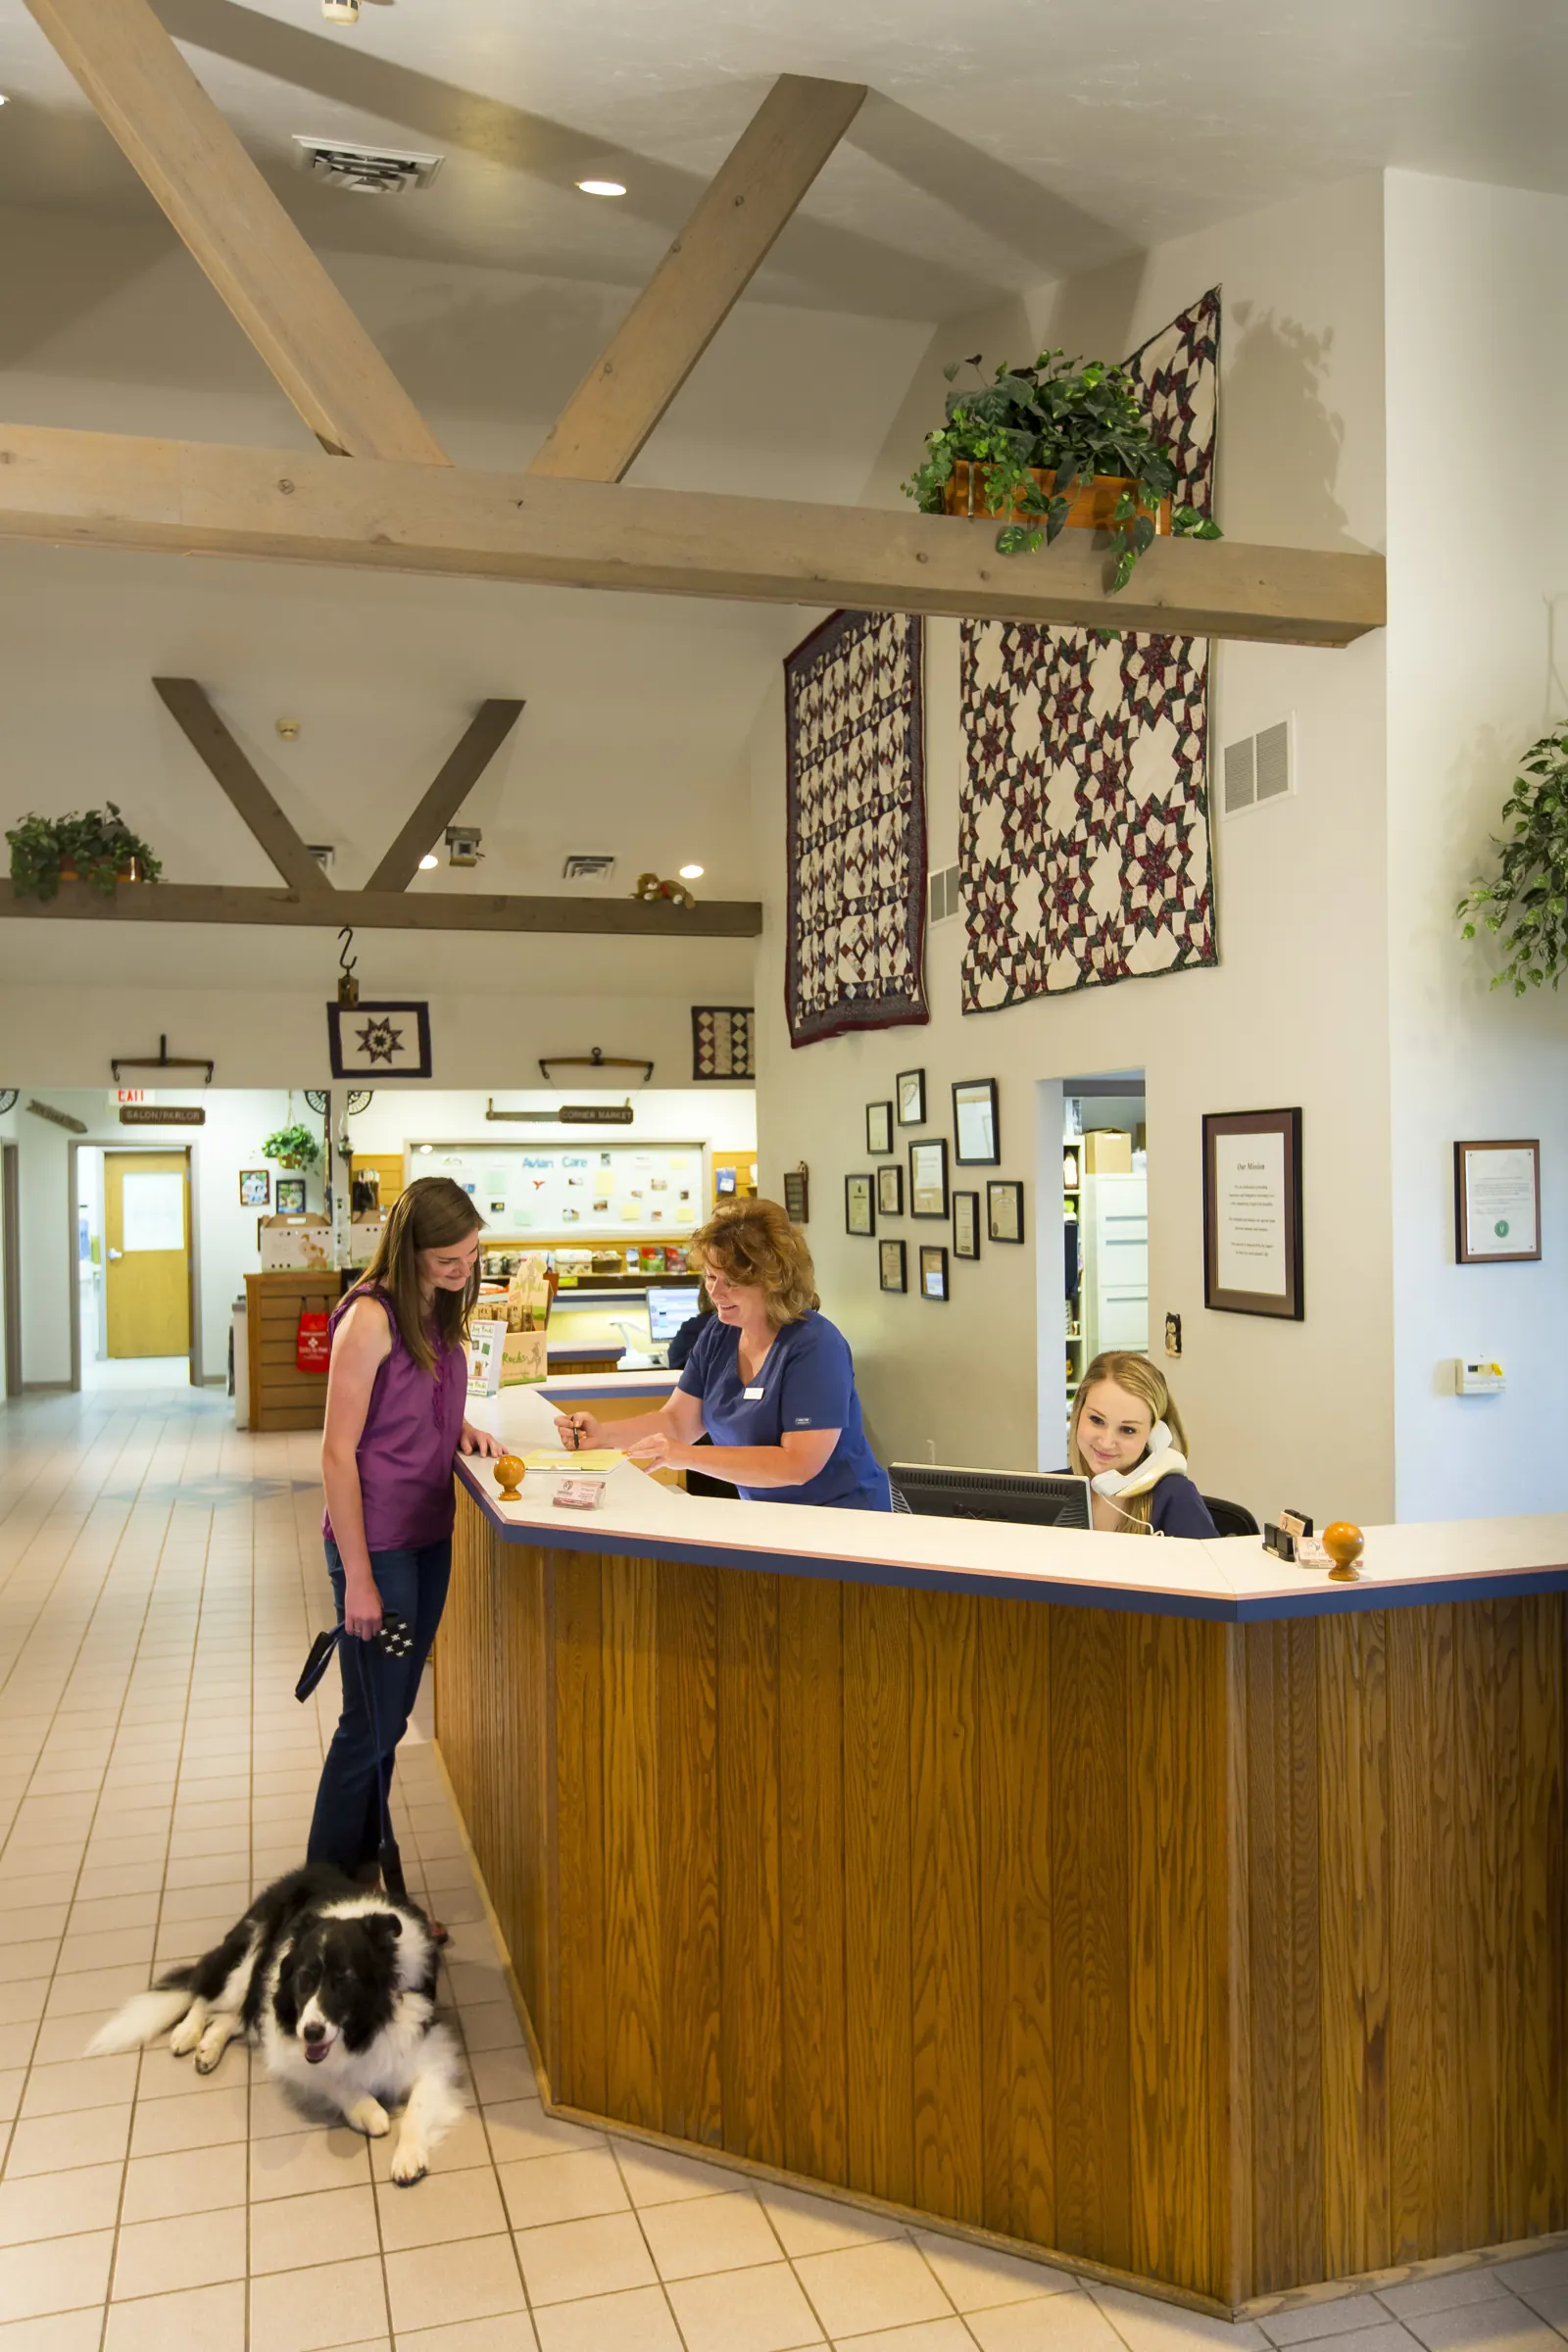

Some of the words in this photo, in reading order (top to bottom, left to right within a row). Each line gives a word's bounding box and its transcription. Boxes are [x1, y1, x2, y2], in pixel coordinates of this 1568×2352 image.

[126, 1110, 200, 1121] SALON/PARLOR
[563, 1110, 596, 1120] CORNER
[598, 1110, 632, 1120] MARKET
[522, 1156, 554, 1169] Avian
[562, 1155, 588, 1168] Care
